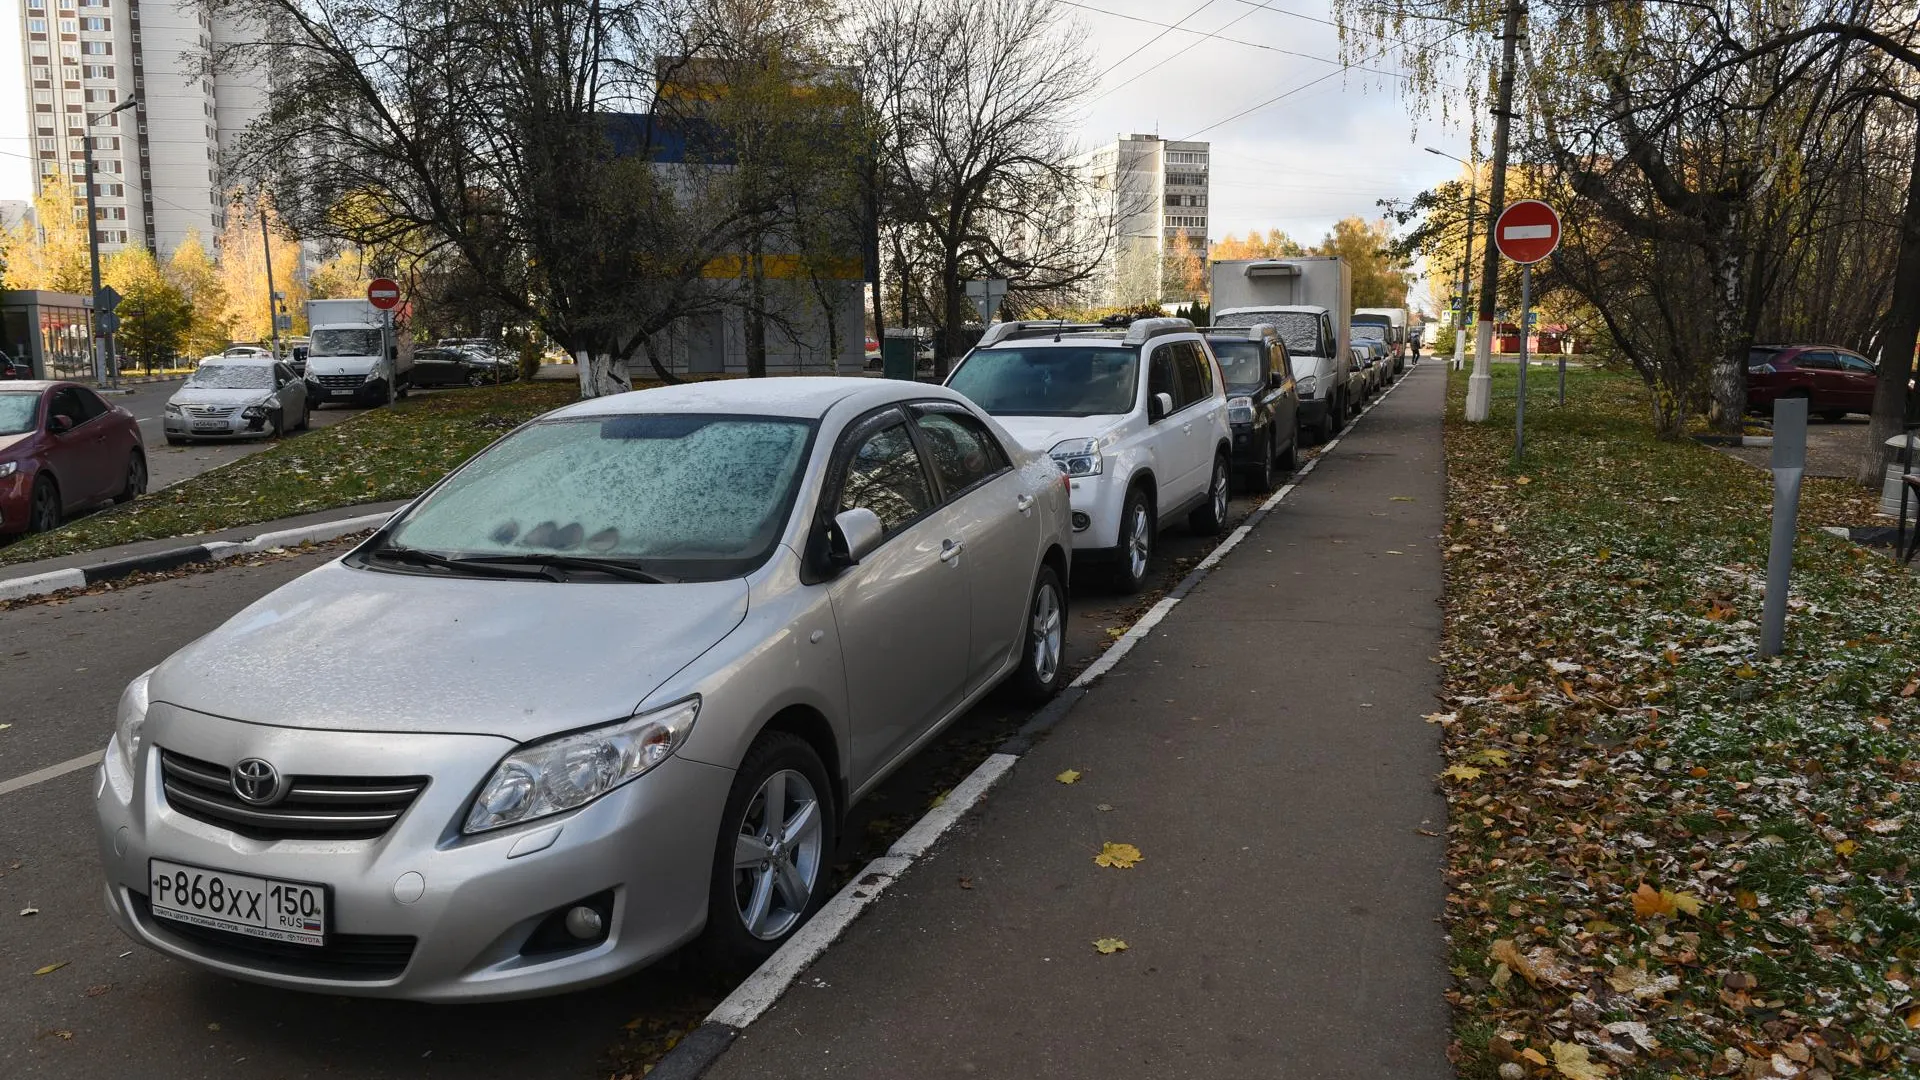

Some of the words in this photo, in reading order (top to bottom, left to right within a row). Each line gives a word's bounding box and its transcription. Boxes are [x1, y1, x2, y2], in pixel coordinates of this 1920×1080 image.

[270, 885, 315, 917] 150
[279, 916, 303, 928] RUS
[296, 935, 321, 944] TOYOTA
